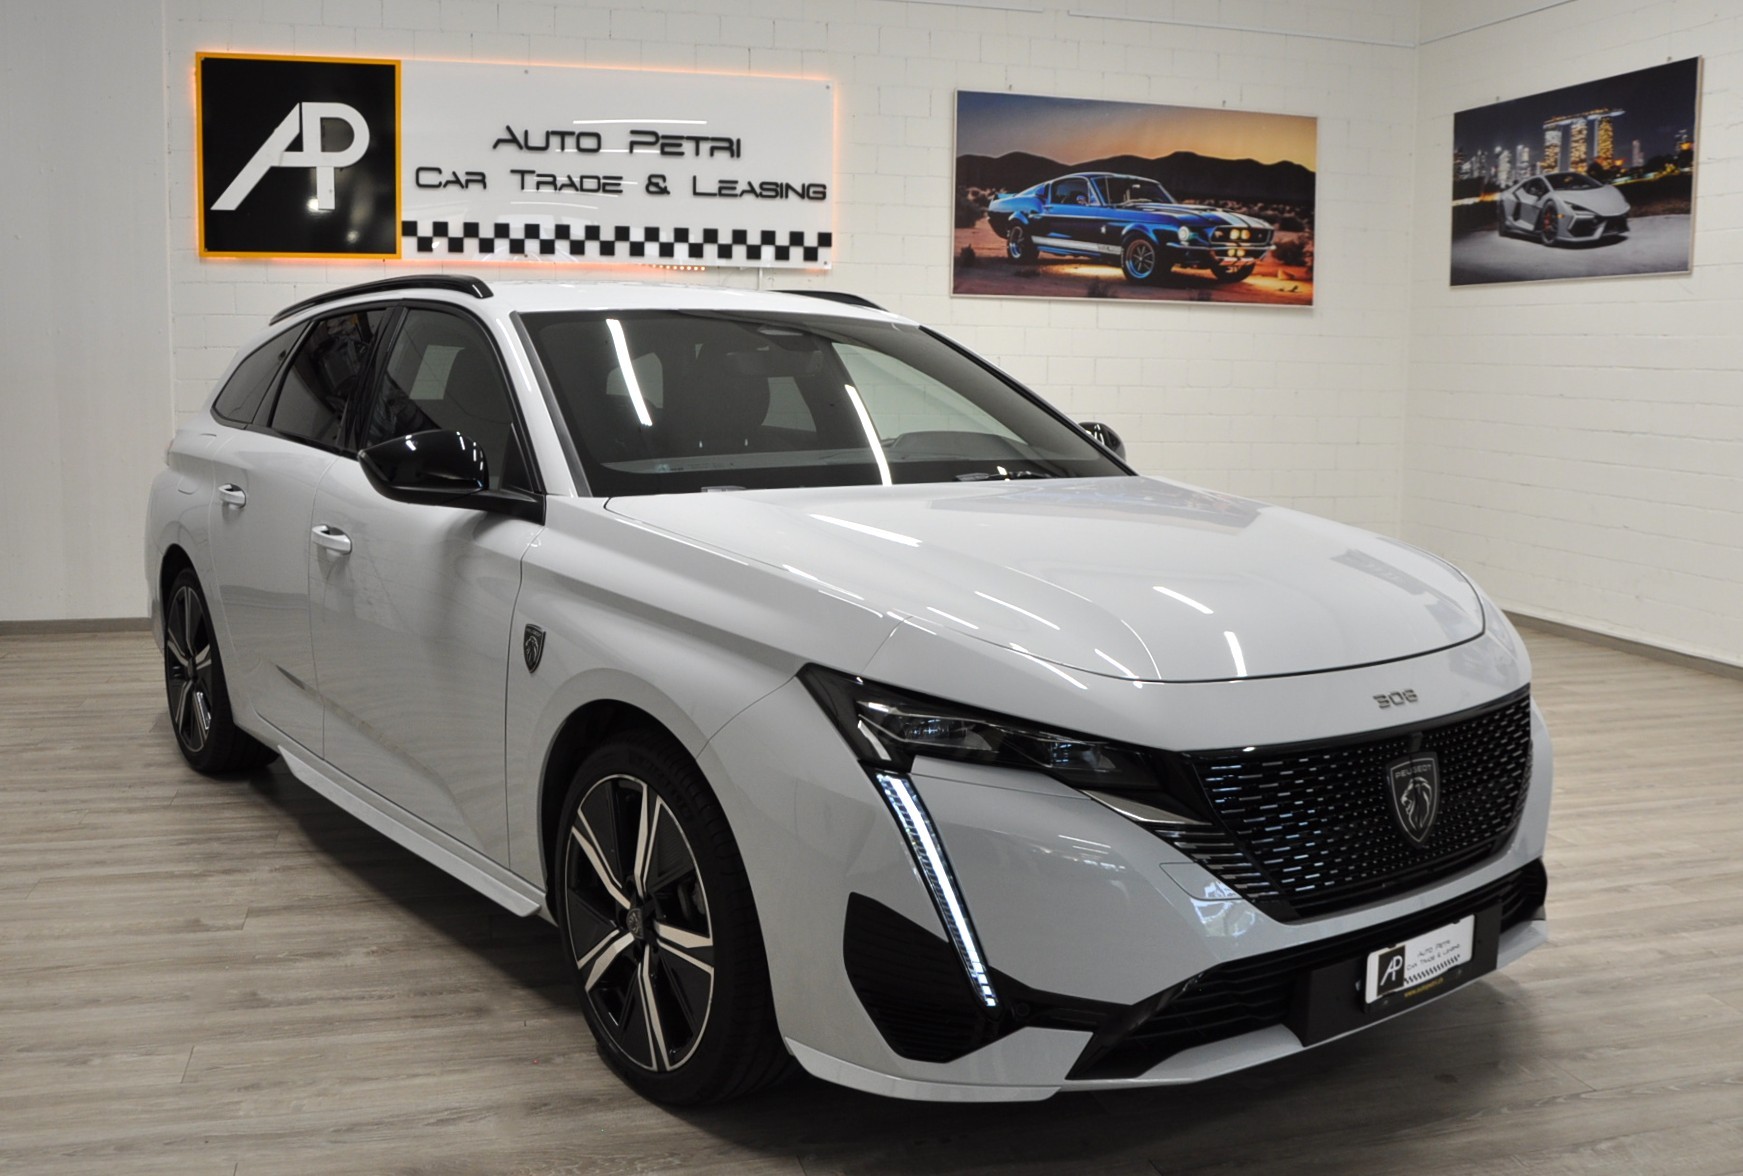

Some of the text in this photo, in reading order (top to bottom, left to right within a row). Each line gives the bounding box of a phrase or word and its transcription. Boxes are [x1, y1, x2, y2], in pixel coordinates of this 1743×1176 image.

[210, 101, 370, 211] AP
[492, 124, 741, 158] AUTO PETRI
[415, 166, 827, 200] CAR TRADE & LEASING
[1379, 955, 1404, 987] AP
